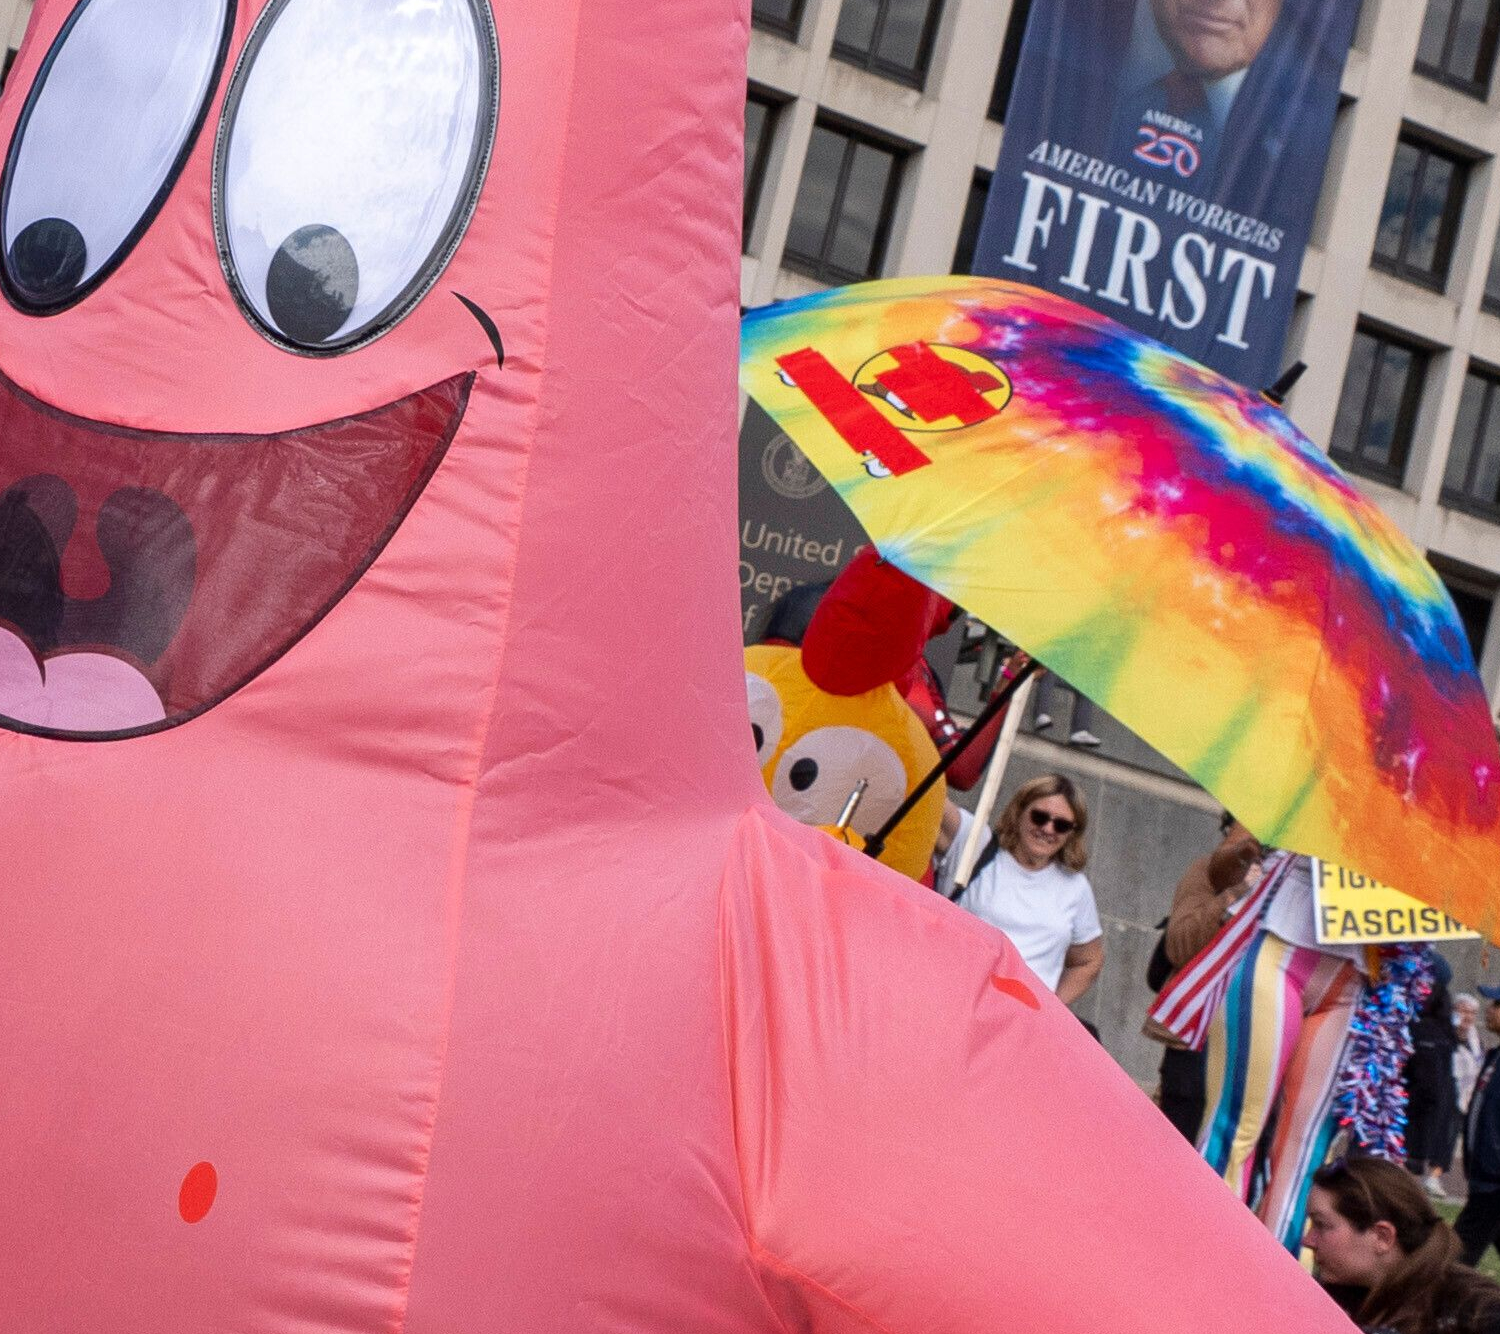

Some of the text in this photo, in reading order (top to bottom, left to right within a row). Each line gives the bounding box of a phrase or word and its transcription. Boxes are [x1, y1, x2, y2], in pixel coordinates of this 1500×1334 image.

[1142, 108, 1204, 143] AMERICA
[1131, 125, 1201, 179] 250
[1028, 138, 1286, 254] AMERICAN WORKERS
[1002, 170, 1278, 351] FIRST
[741, 519, 844, 567] United
[744, 604, 759, 633] f
